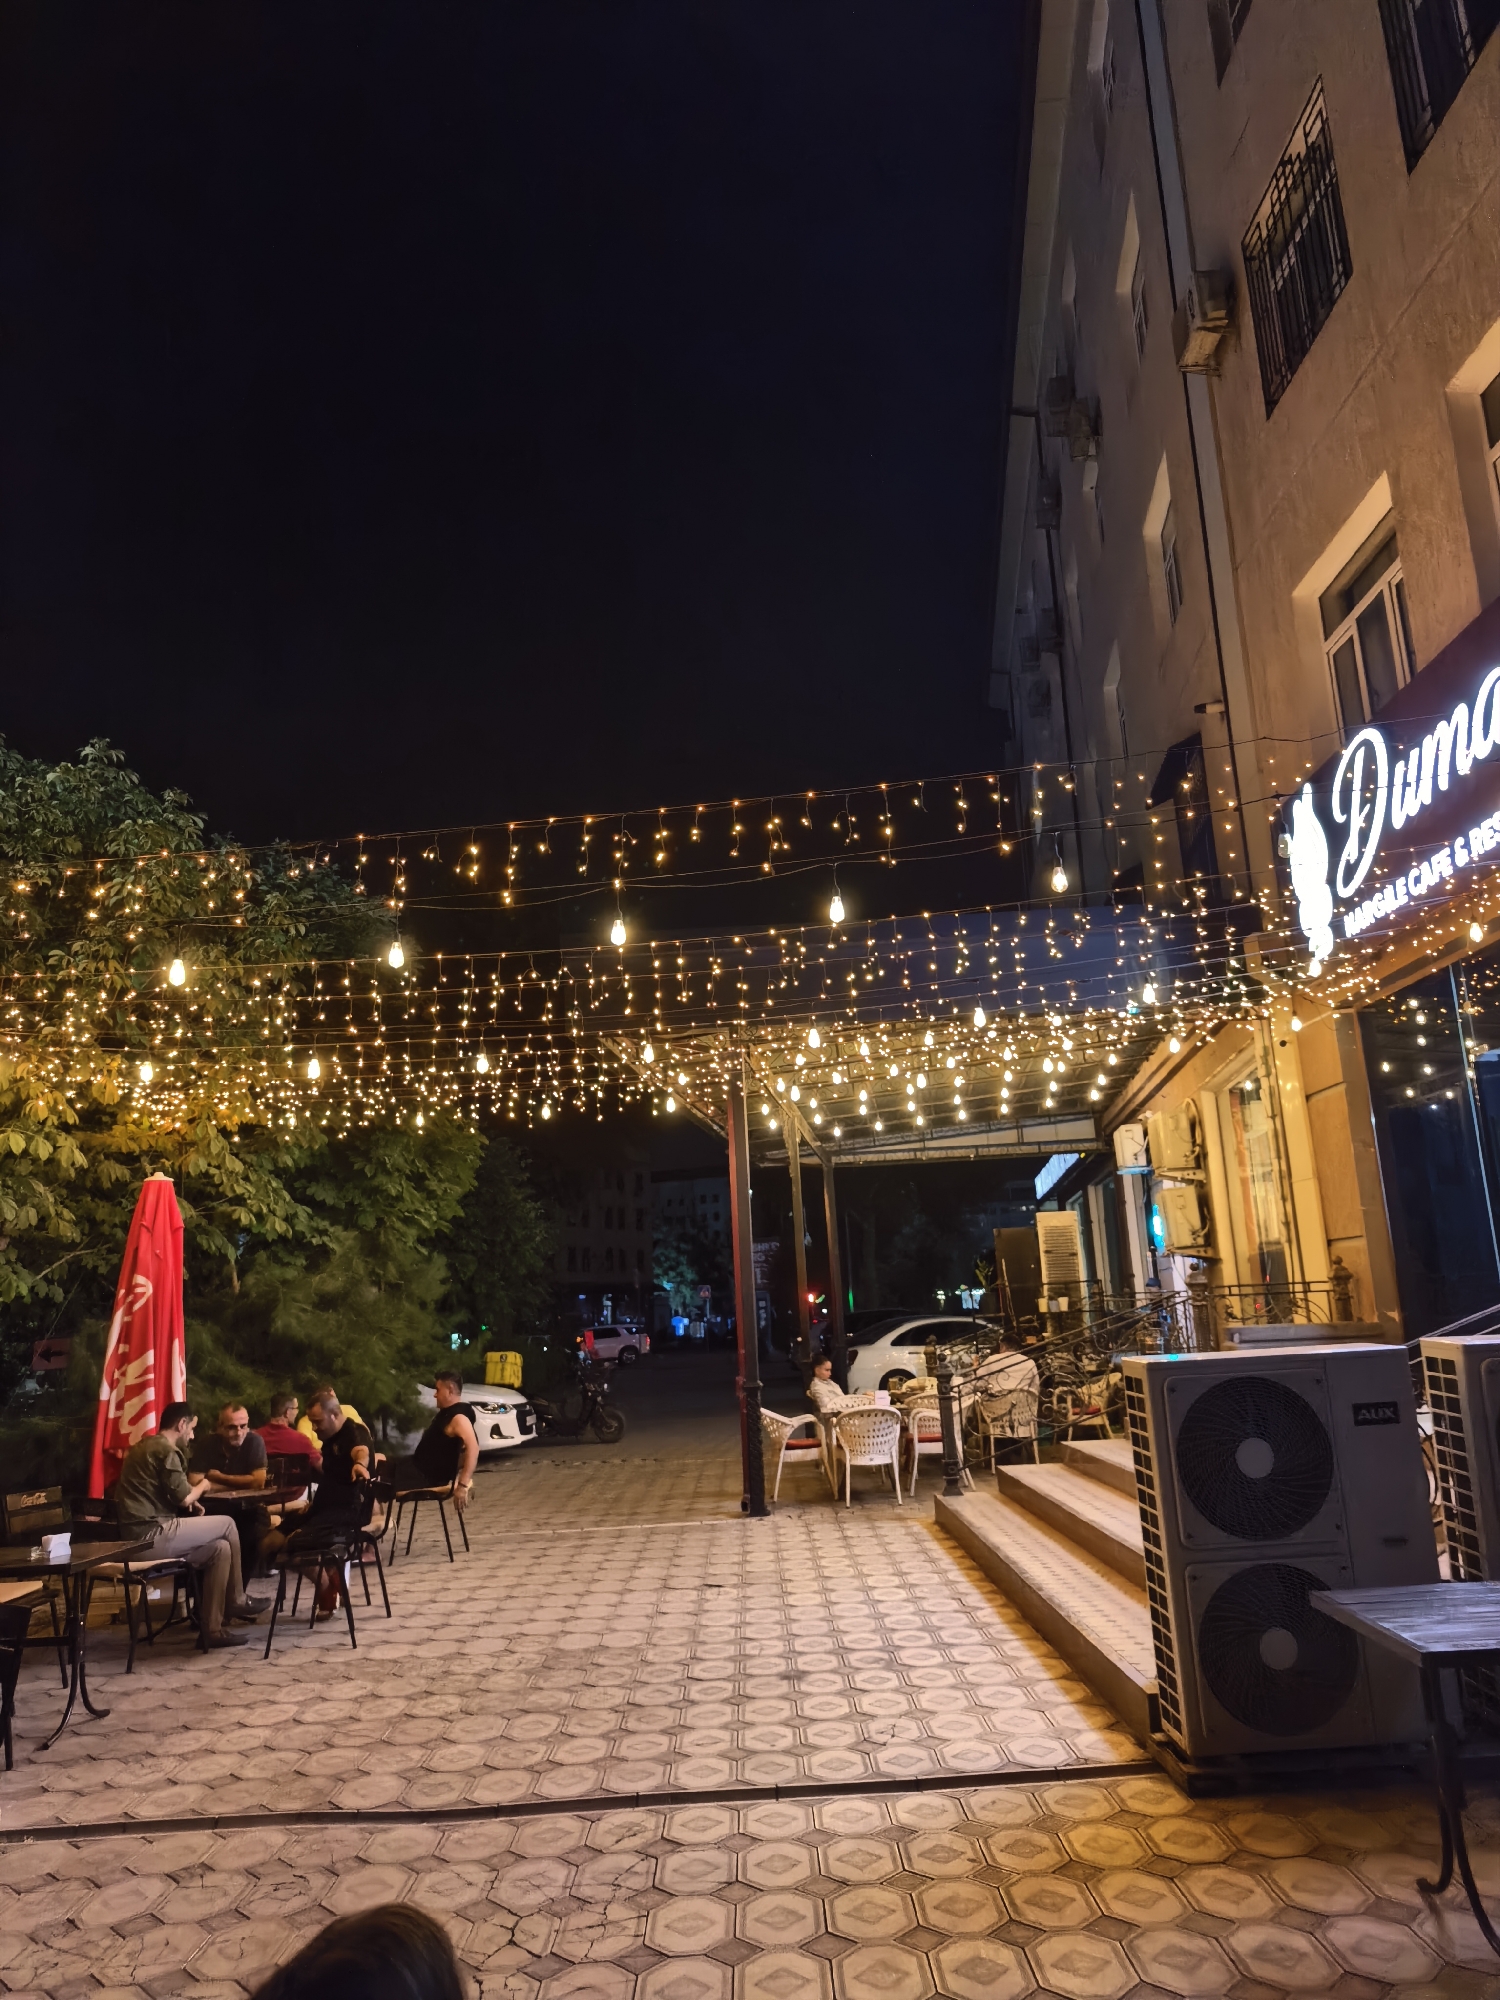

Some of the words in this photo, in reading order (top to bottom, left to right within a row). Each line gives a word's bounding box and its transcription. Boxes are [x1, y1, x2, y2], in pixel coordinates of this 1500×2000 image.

[1408, 847, 1454, 896] CAFE
[1454, 836, 1469, 867] &
[1359, 1407, 1396, 1420] AUX
